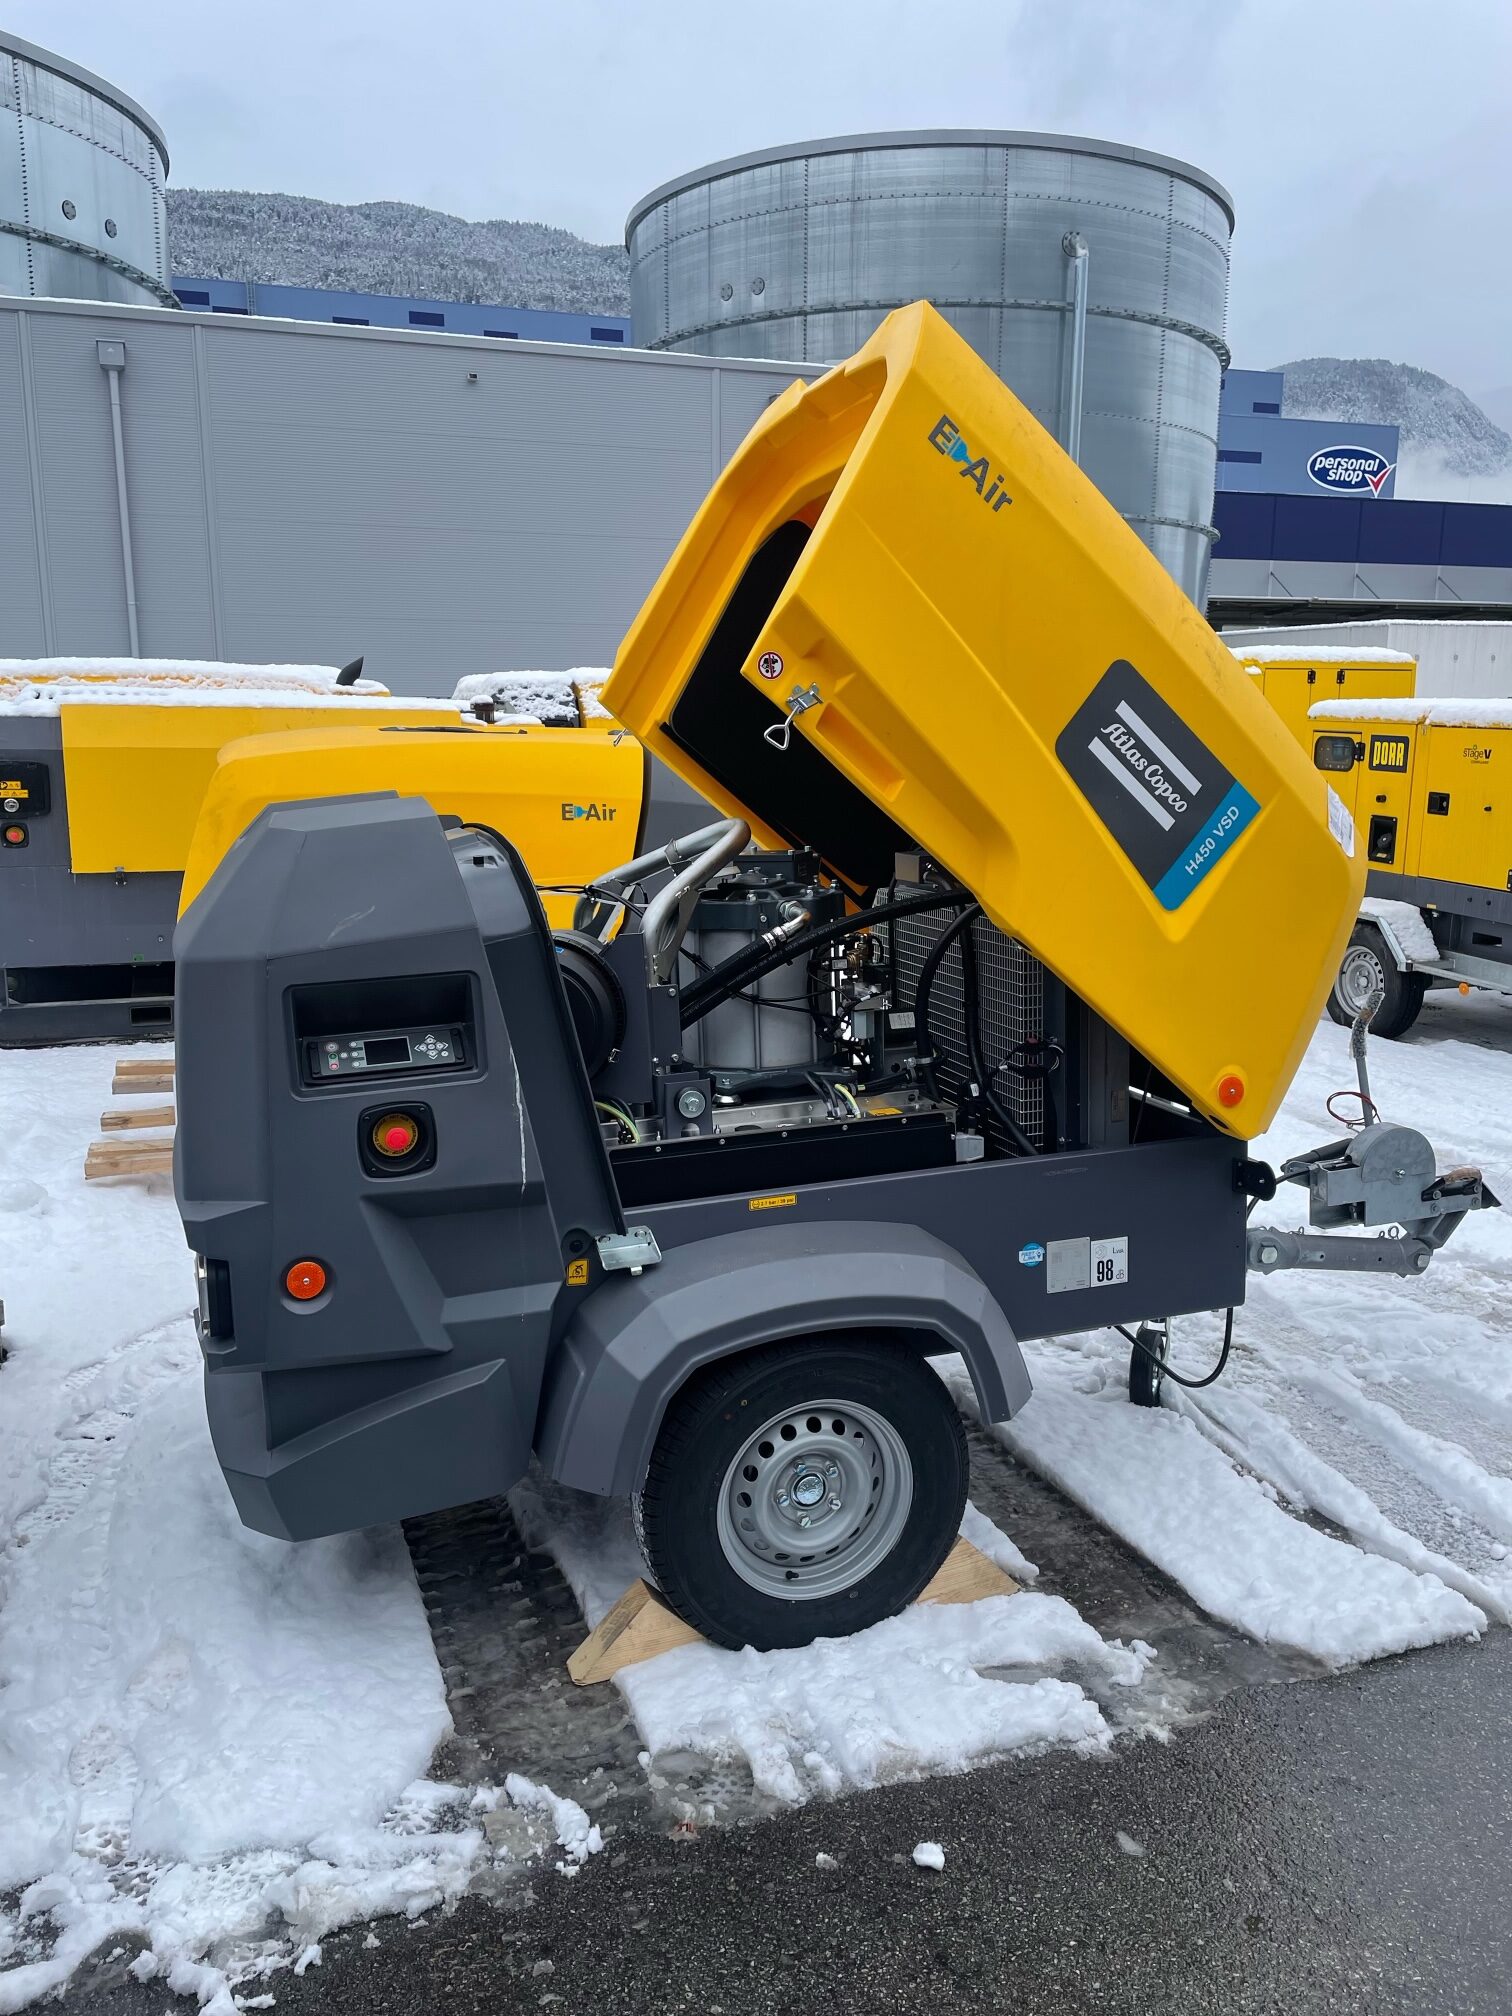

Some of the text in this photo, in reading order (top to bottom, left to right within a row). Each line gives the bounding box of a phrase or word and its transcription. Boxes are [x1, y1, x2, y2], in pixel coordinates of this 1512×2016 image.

[1314, 456, 1380, 471] personal
[1326, 465, 1363, 485] shop
[1100, 723, 1188, 812] Atlas Copco
[1185, 805, 1240, 876] H450 VSD
[1097, 1259, 1114, 1282] 98
